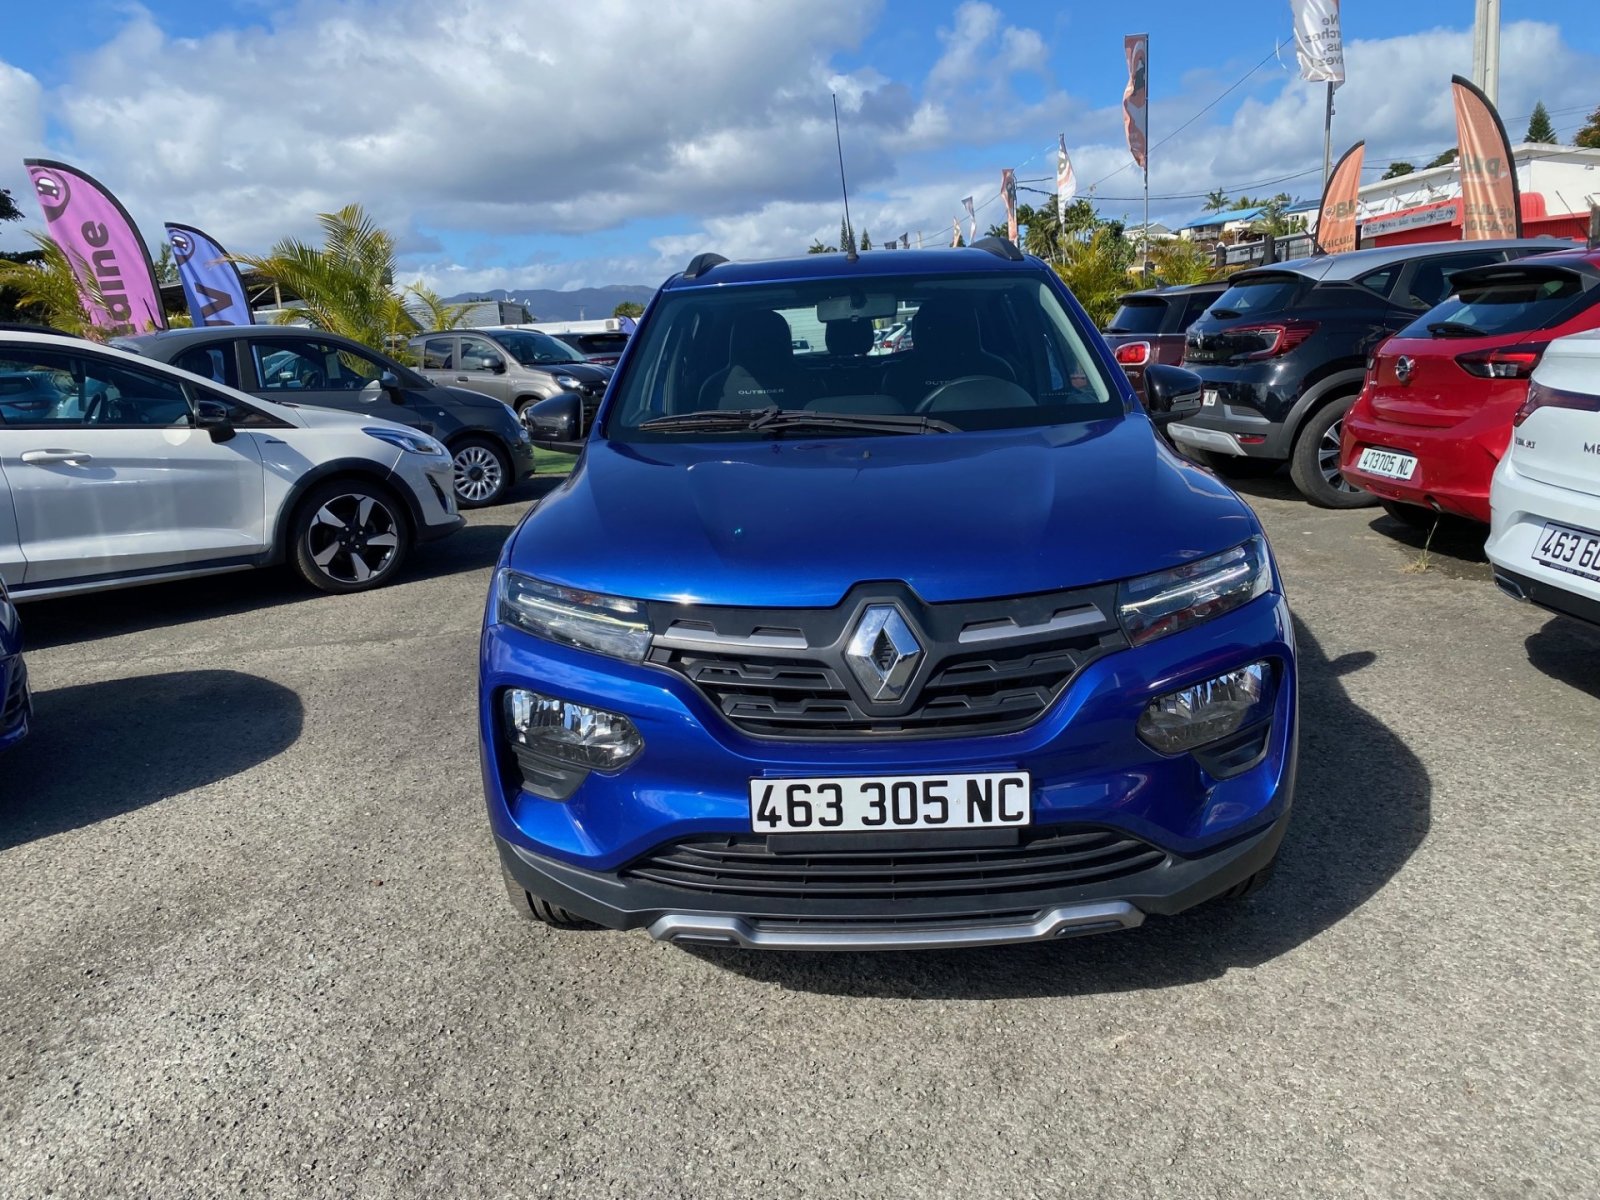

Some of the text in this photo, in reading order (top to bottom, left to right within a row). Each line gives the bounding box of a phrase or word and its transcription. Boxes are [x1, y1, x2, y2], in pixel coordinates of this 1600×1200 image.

[1397, 458, 1413, 476] NC
[1541, 530, 1582, 563] 463
[757, 778, 1024, 828] 463 305 NC
